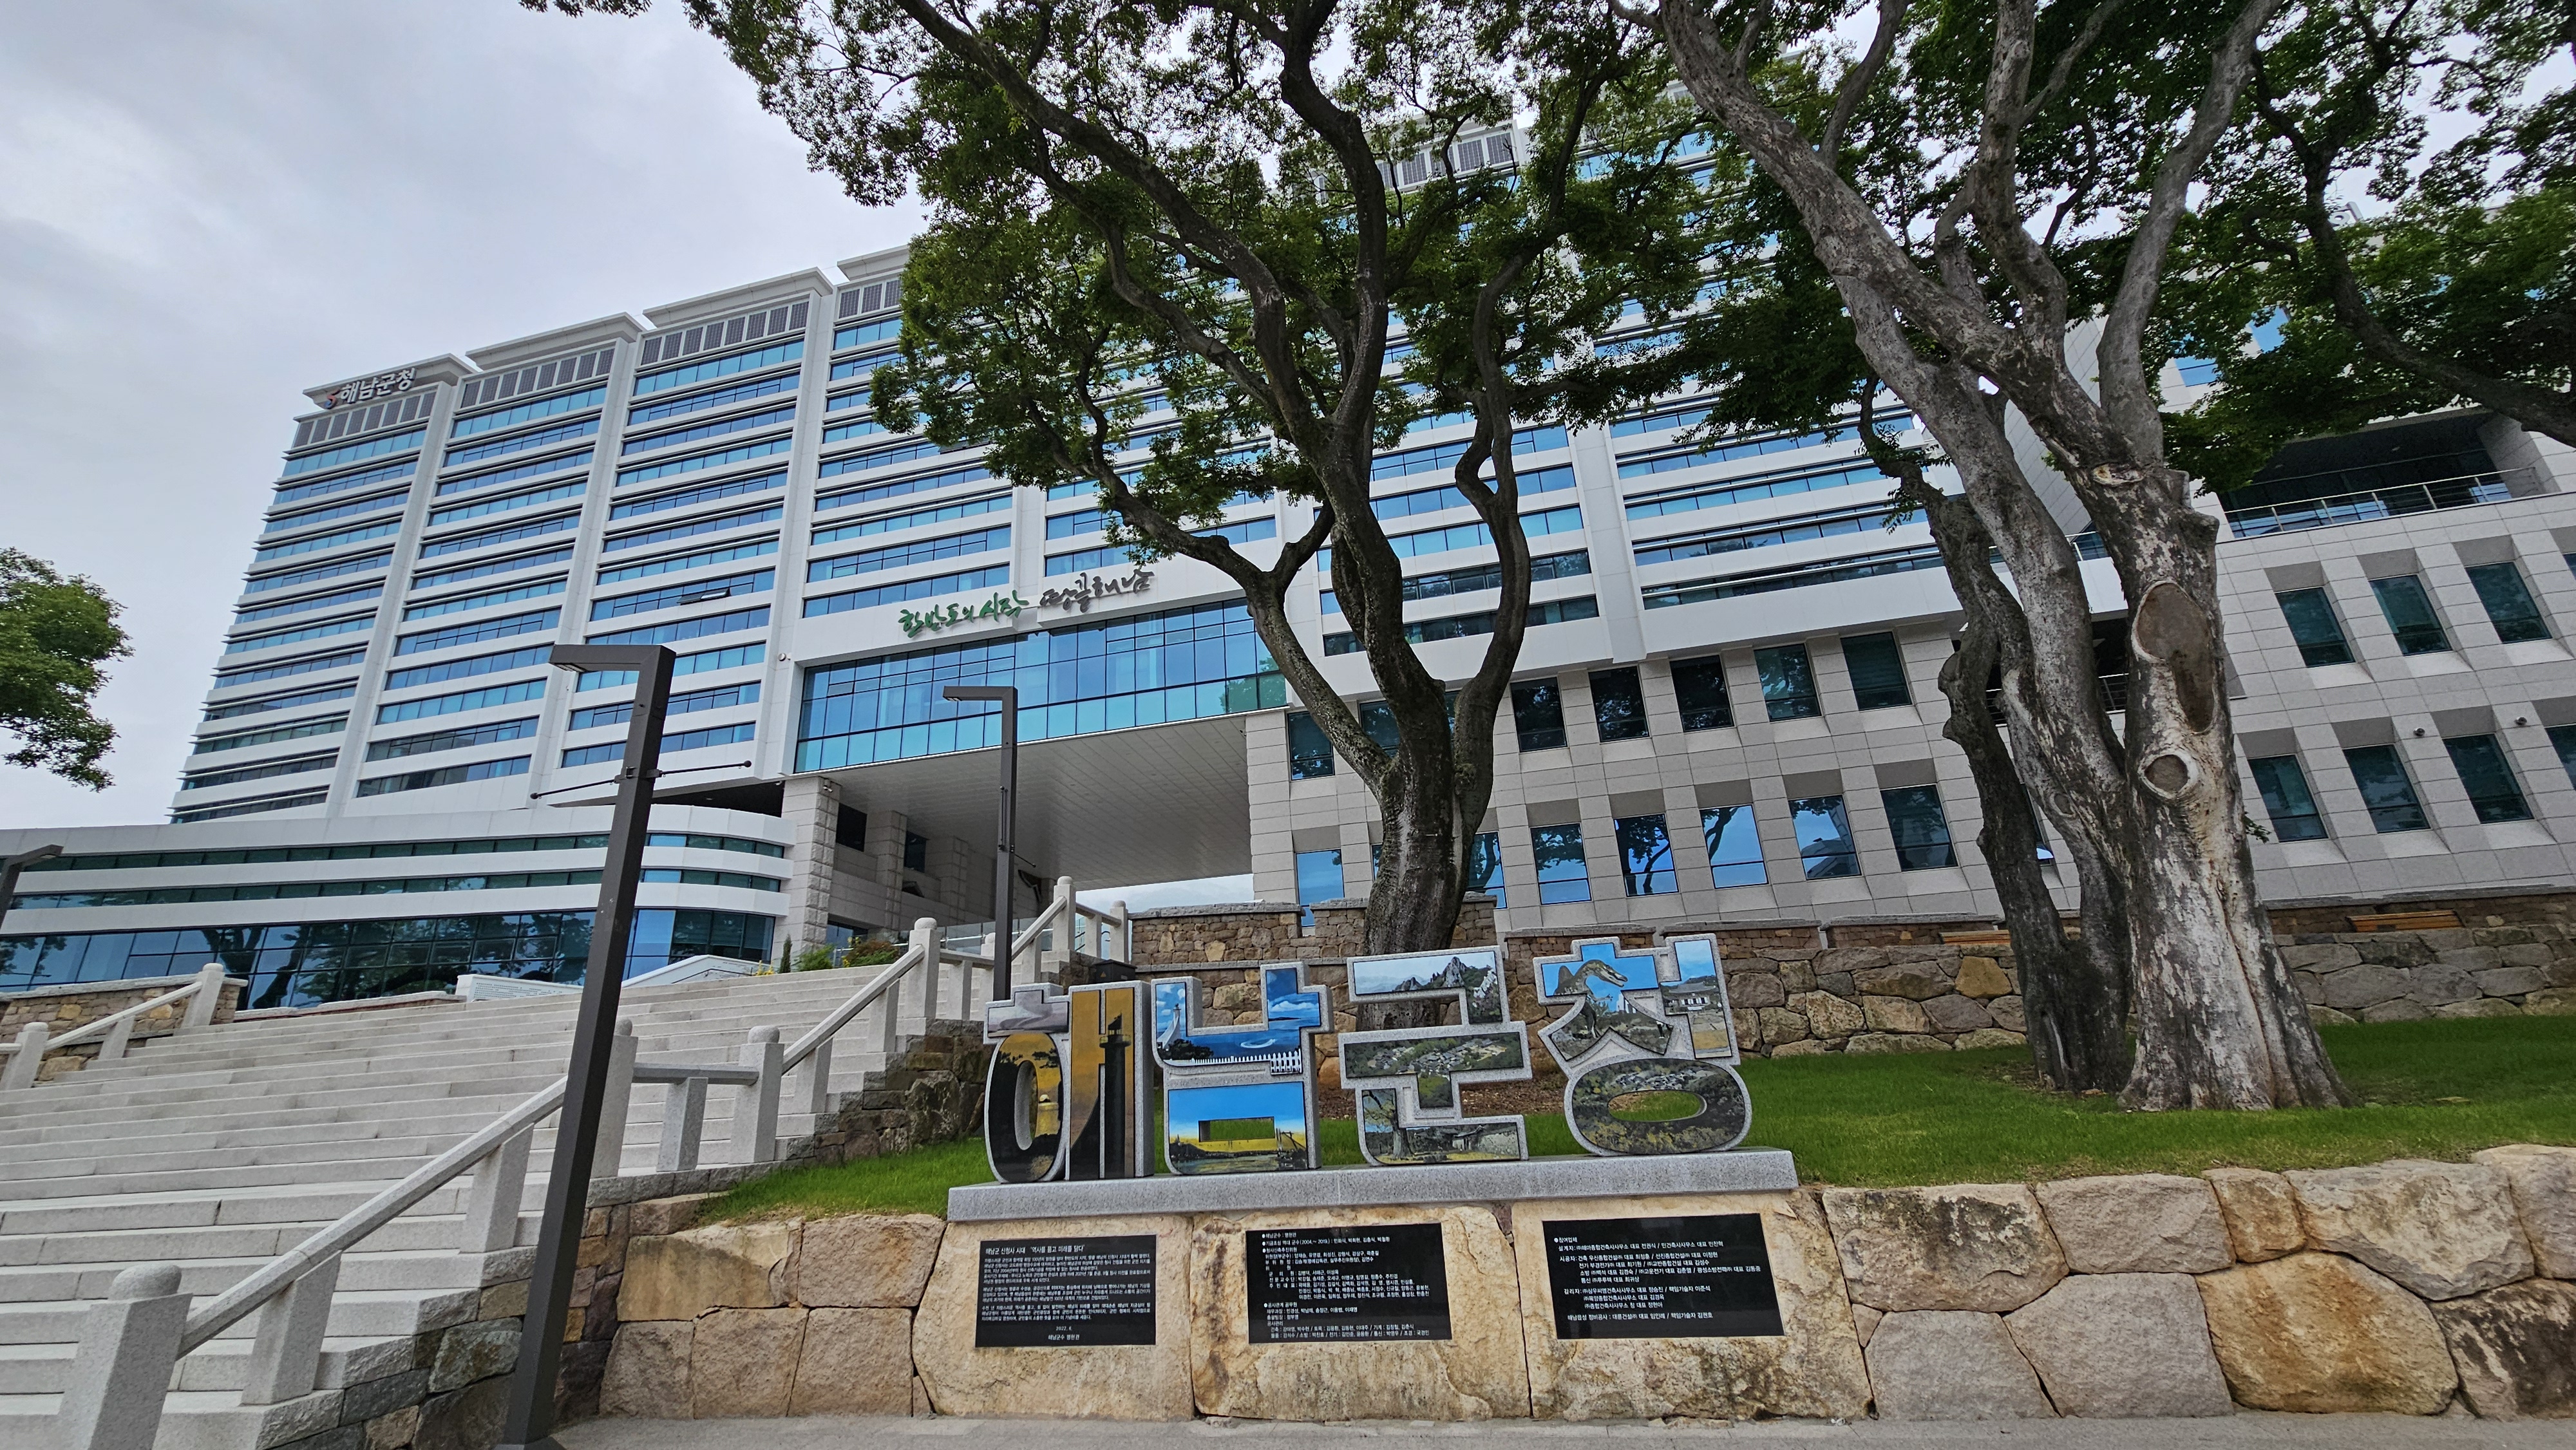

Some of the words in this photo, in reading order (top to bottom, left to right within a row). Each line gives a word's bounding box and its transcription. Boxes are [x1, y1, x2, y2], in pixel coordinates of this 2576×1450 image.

[341, 368, 415, 404] 해남군청
[898, 605, 974, 637] 한반도의
[979, 590, 1029, 622] 시작
[984, 933, 1752, 1183] 해남군청
[1000, 1247, 1015, 1255] 신청사
[1057, 1245, 1072, 1253] 미래를
